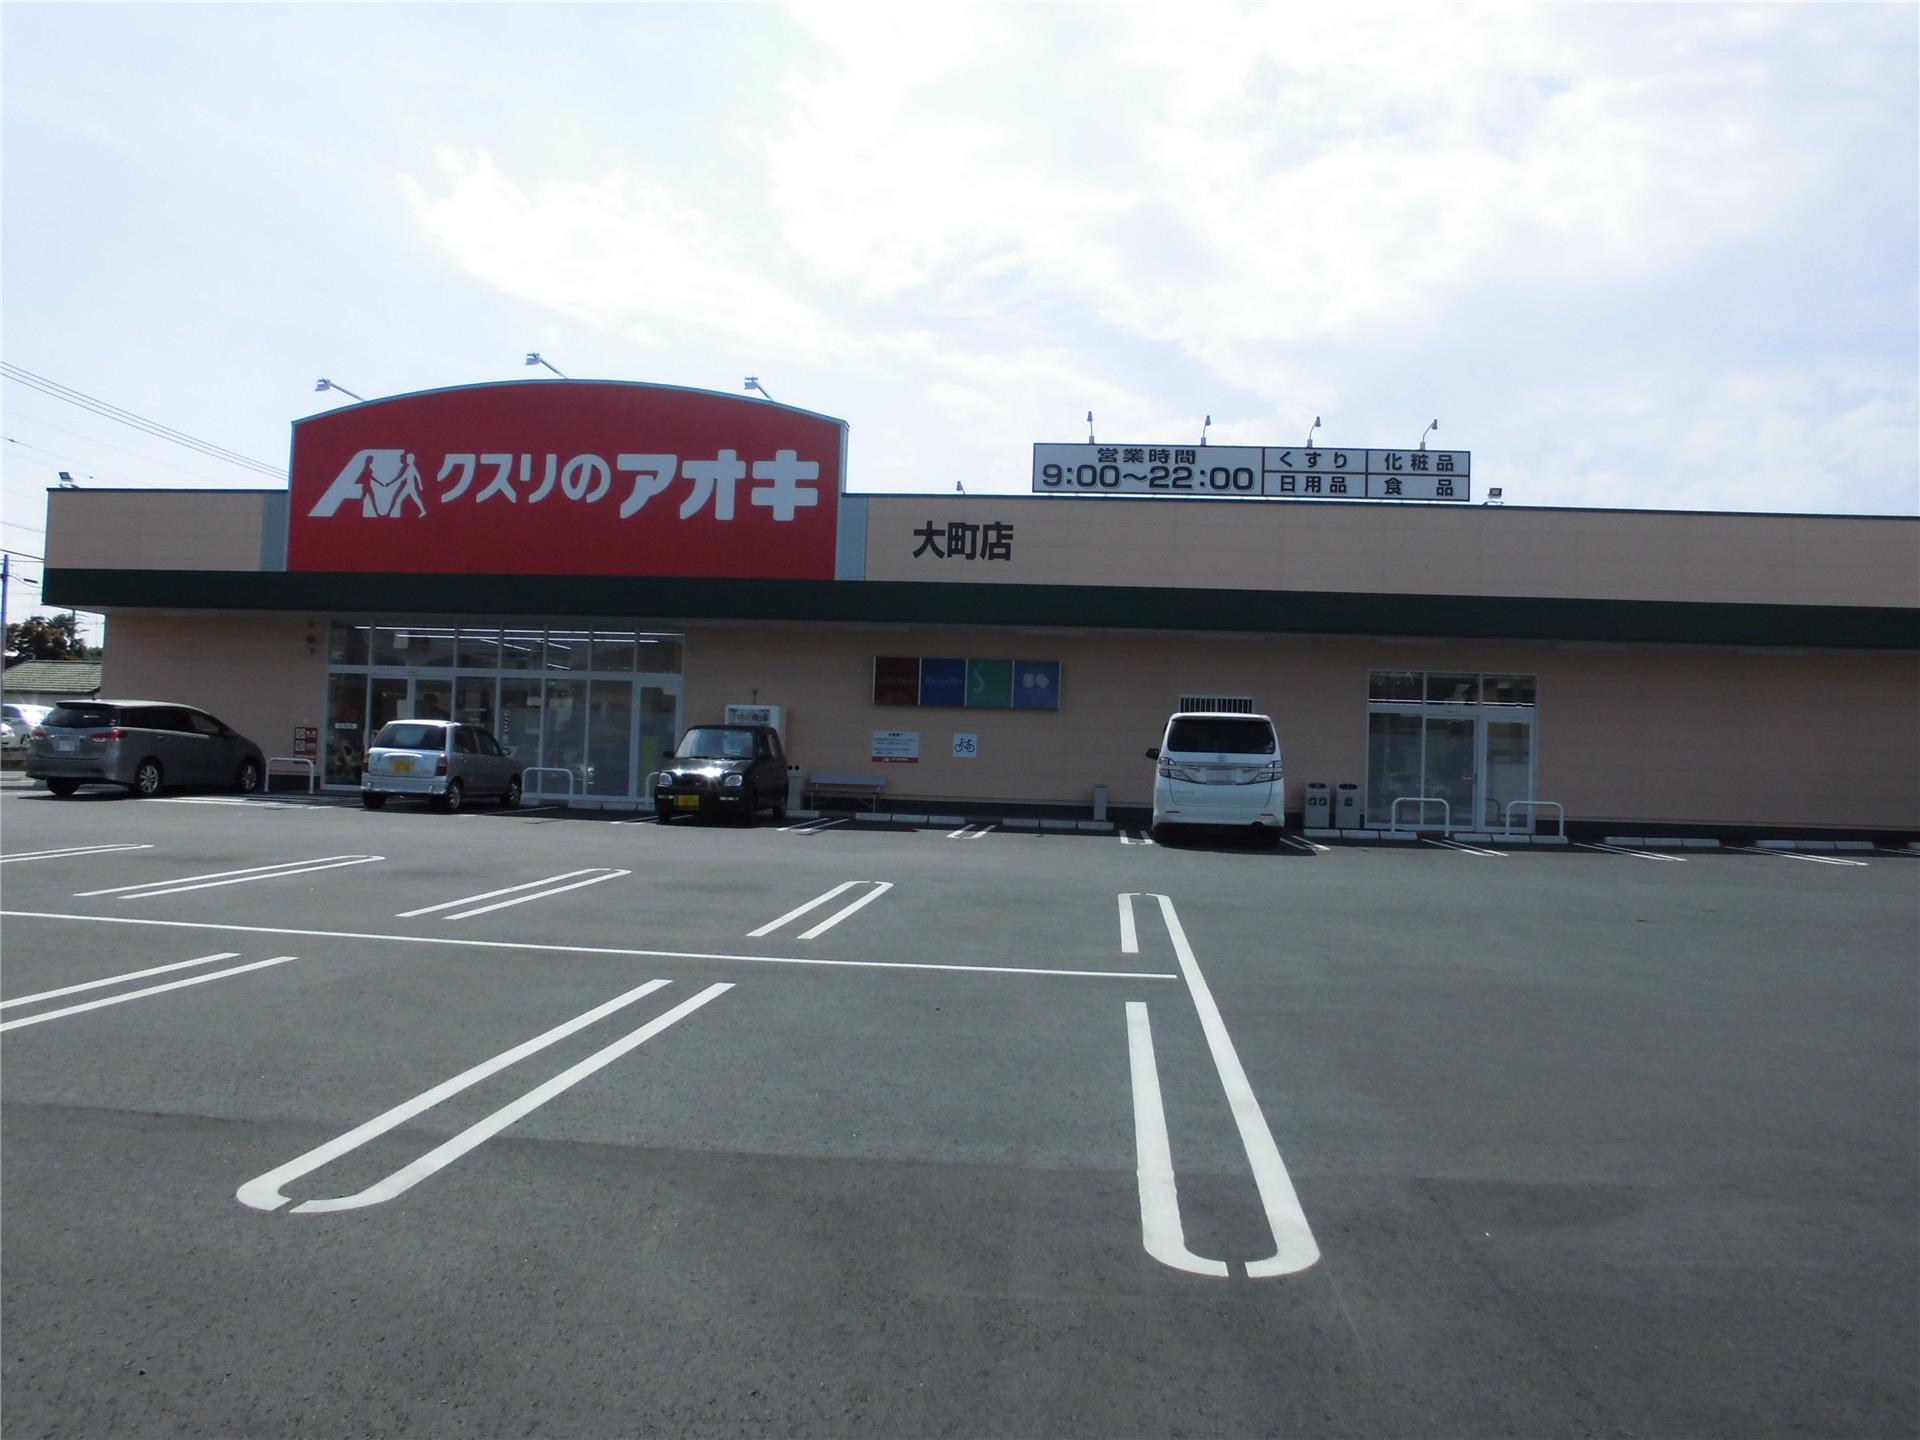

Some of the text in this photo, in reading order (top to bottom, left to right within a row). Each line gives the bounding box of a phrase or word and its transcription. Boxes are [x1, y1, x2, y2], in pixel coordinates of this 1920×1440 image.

[1097, 448, 1196, 465] 営業時間
[1279, 451, 1348, 469] くすり
[1384, 453, 1454, 472] 化粧品
[437, 449, 819, 521] クスリのアオキ
[1280, 475, 1347, 494] 日用品
[912, 520, 1014, 562] 大町店
